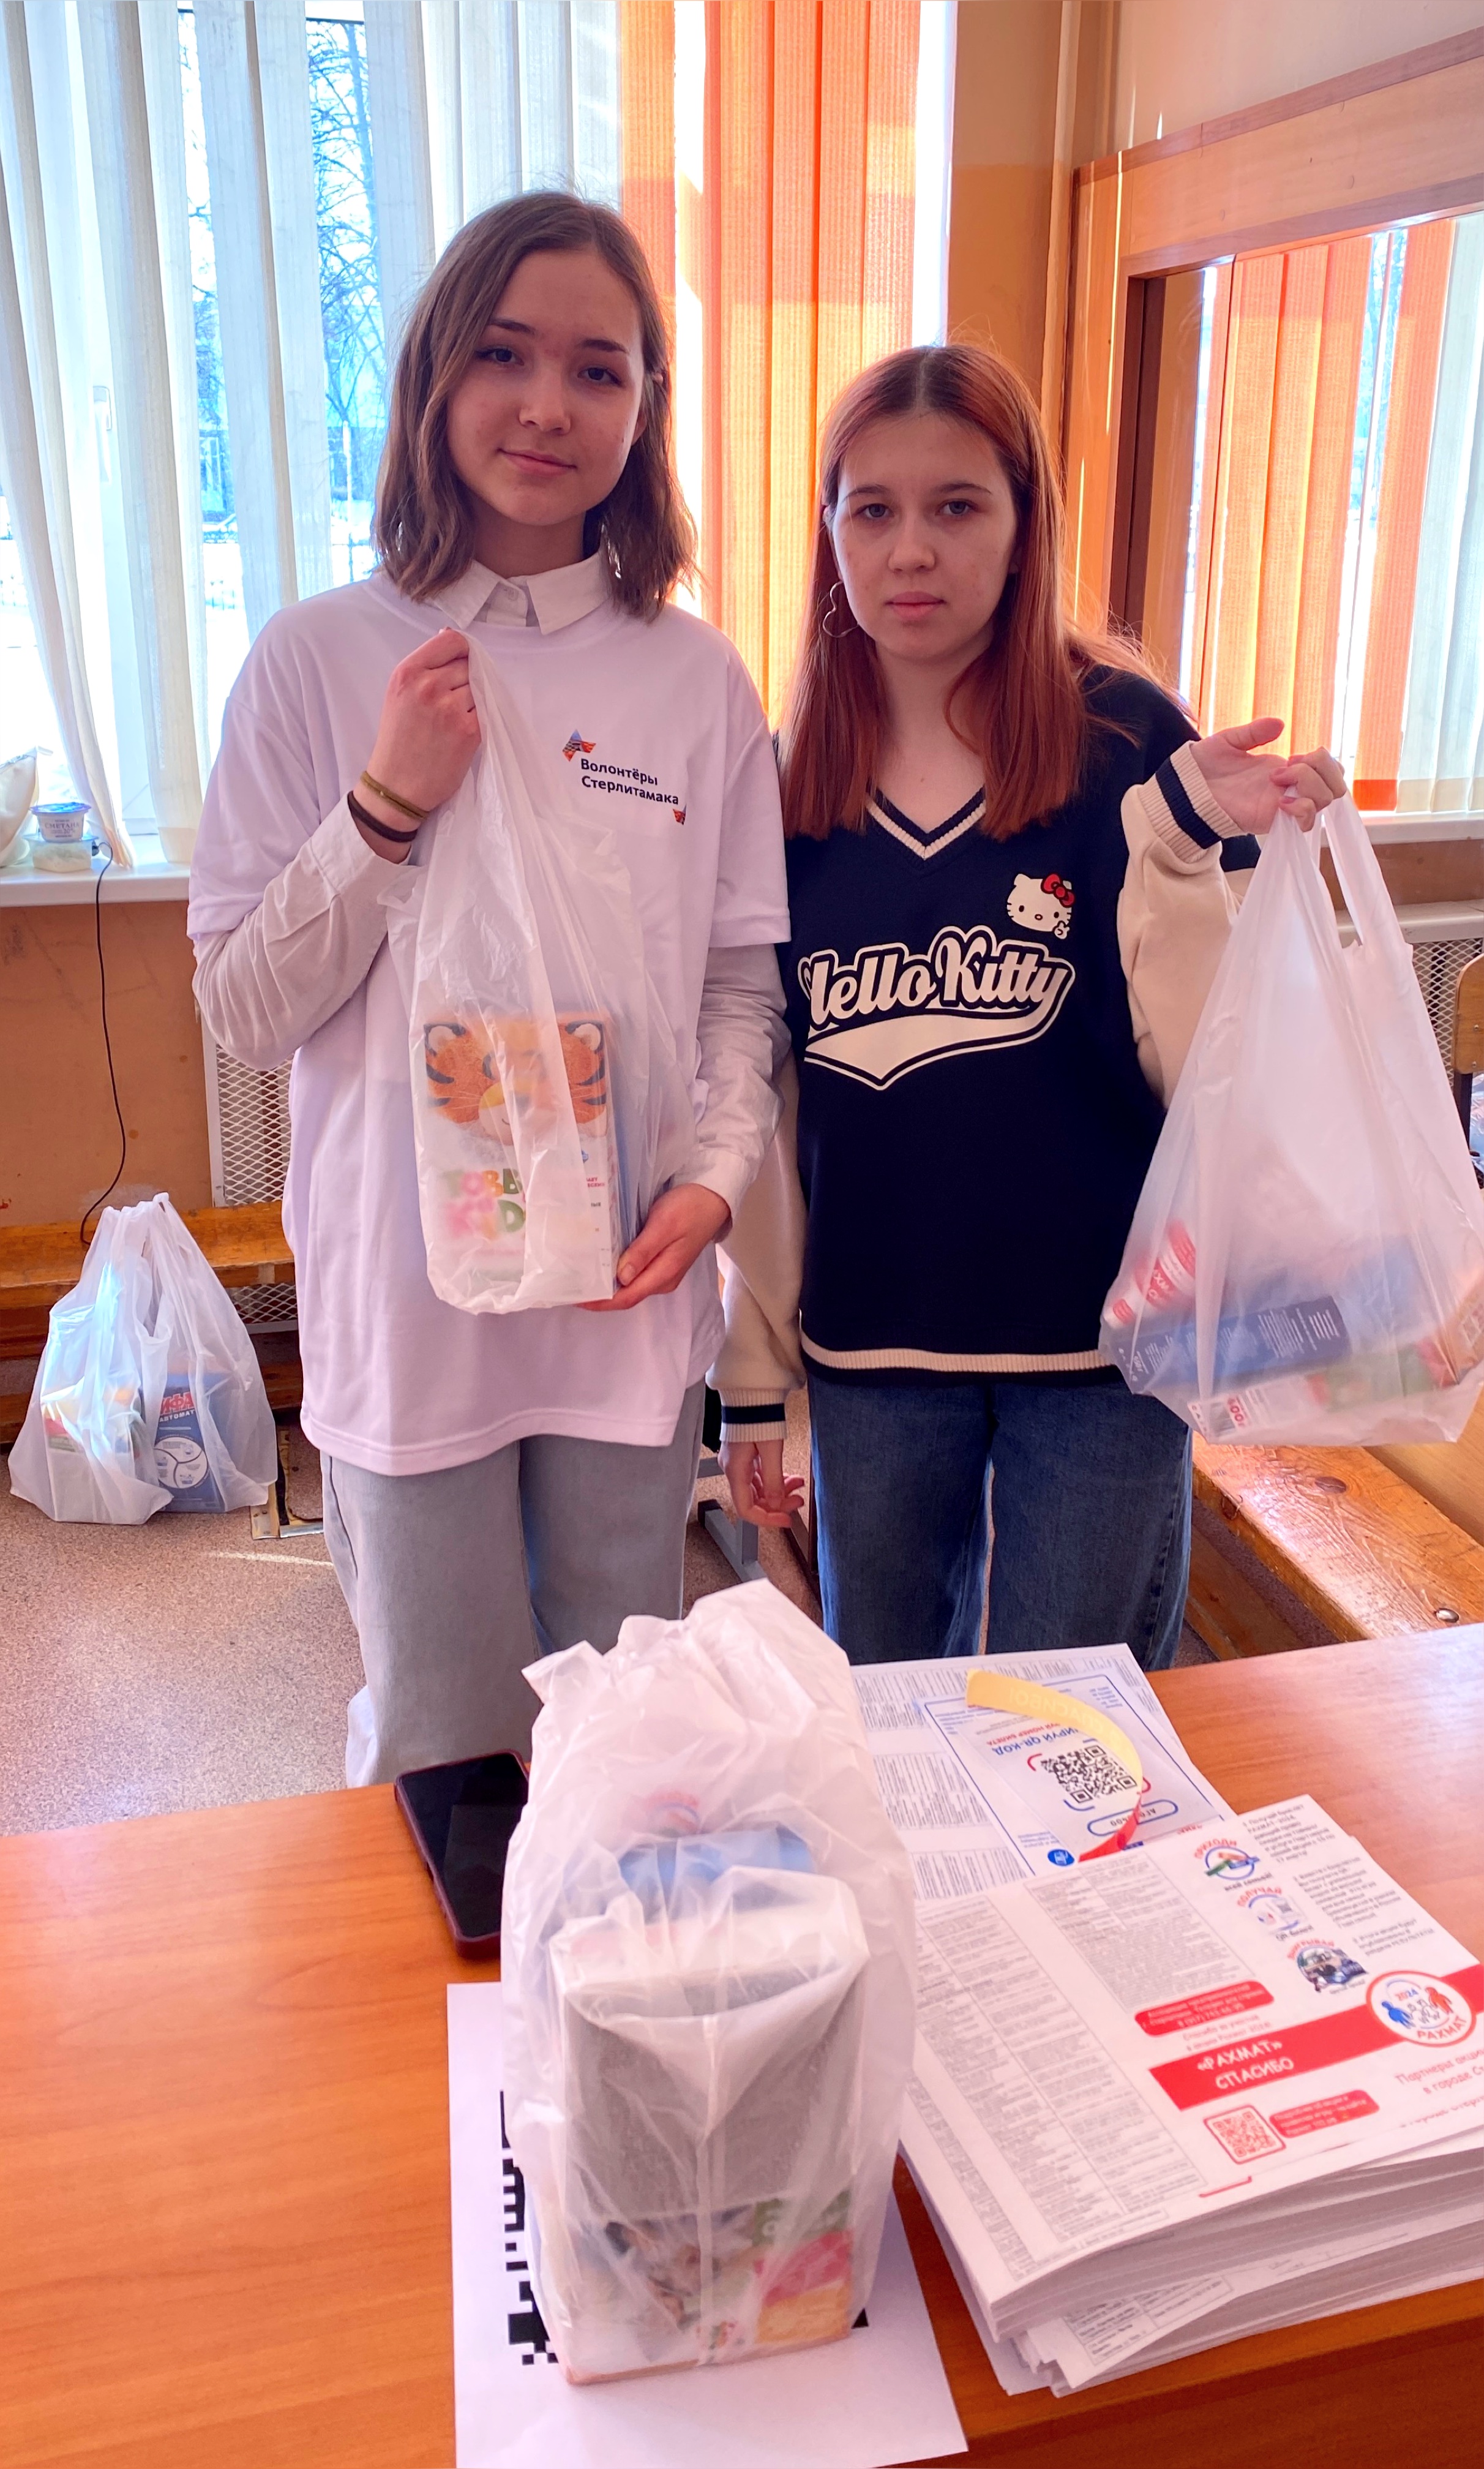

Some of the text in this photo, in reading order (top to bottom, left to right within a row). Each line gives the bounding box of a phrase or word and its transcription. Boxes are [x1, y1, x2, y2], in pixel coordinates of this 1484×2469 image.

[581, 758, 658, 786] Волонтёры
[582, 776, 678, 805] Стерлитамака
[935, 936, 1070, 1007] Kitty
[160, 1391, 195, 1415] ИФА
[160, 1410, 195, 1422] АВТОМАТ
[992, 1734, 1041, 1756] QR-КОД
[1395, 1988, 1418, 2001] 2024
[1417, 2015, 1467, 2039] РАХМАТ
[1197, 2039, 1283, 2071] «РАХМАТ»
[1215, 2056, 1294, 2089] СПАСИБО
[1395, 2060, 1455, 2085] Партнеры
[1432, 2072, 1472, 2091] городе
